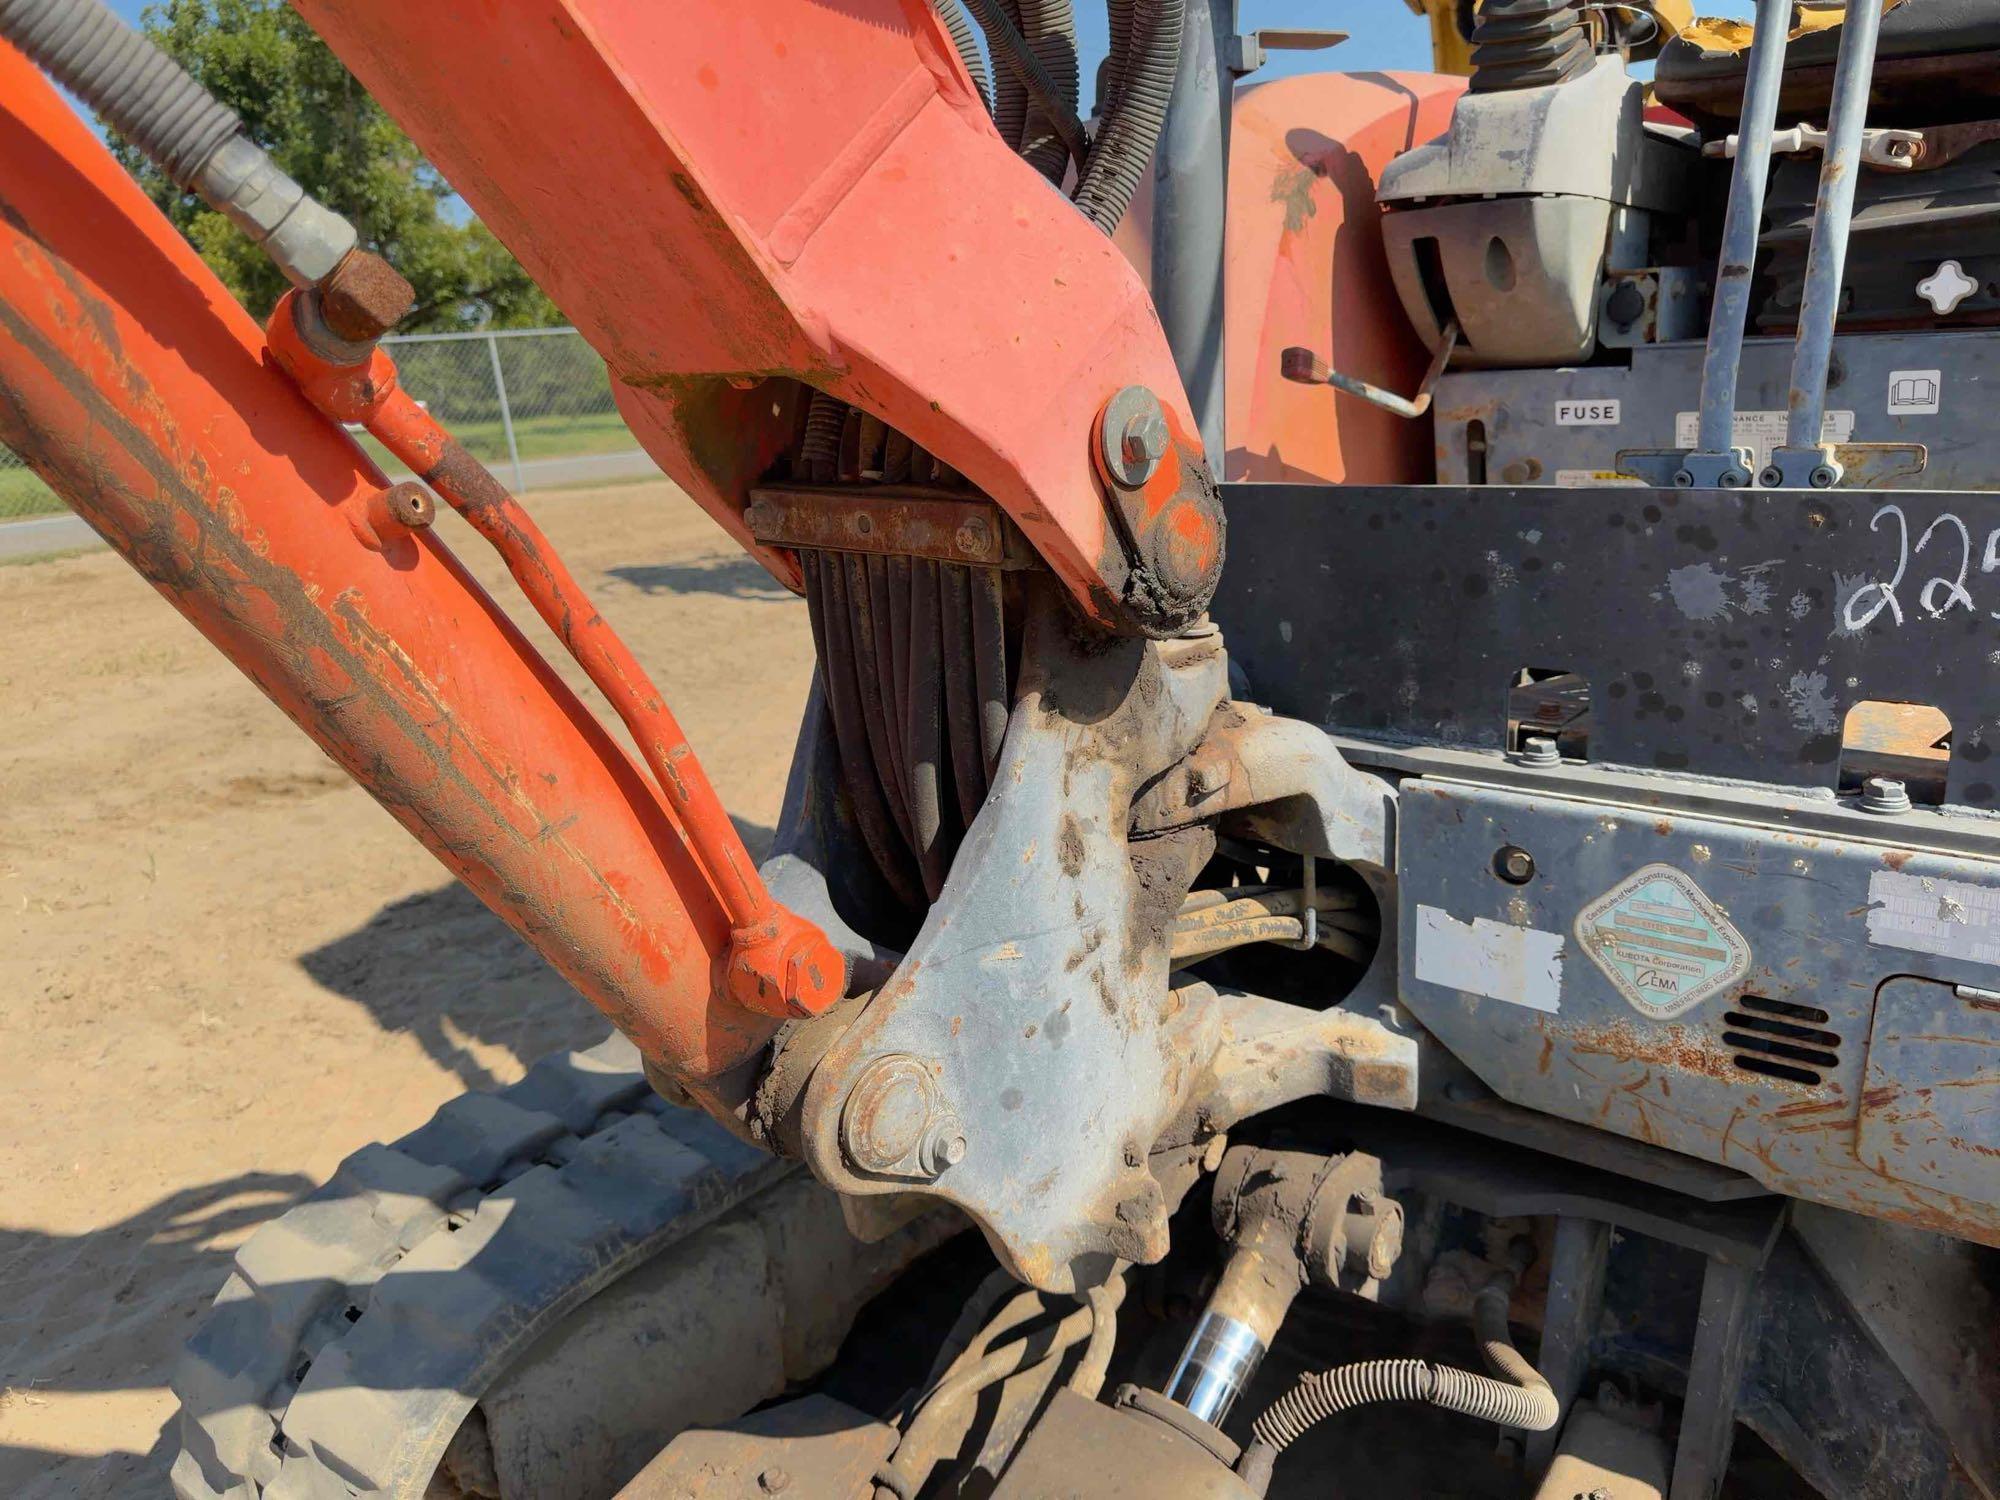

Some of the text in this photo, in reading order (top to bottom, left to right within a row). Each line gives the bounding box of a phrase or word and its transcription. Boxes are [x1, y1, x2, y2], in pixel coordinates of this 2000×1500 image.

[1560, 406, 1614, 421] FUSE
[1623, 882, 1639, 896] New
[1637, 872, 1686, 892] Construction
[1717, 925, 1740, 951] Export
[1616, 948, 1702, 974] KUBOTA Corporation
[1636, 969, 1678, 992] CEMA
